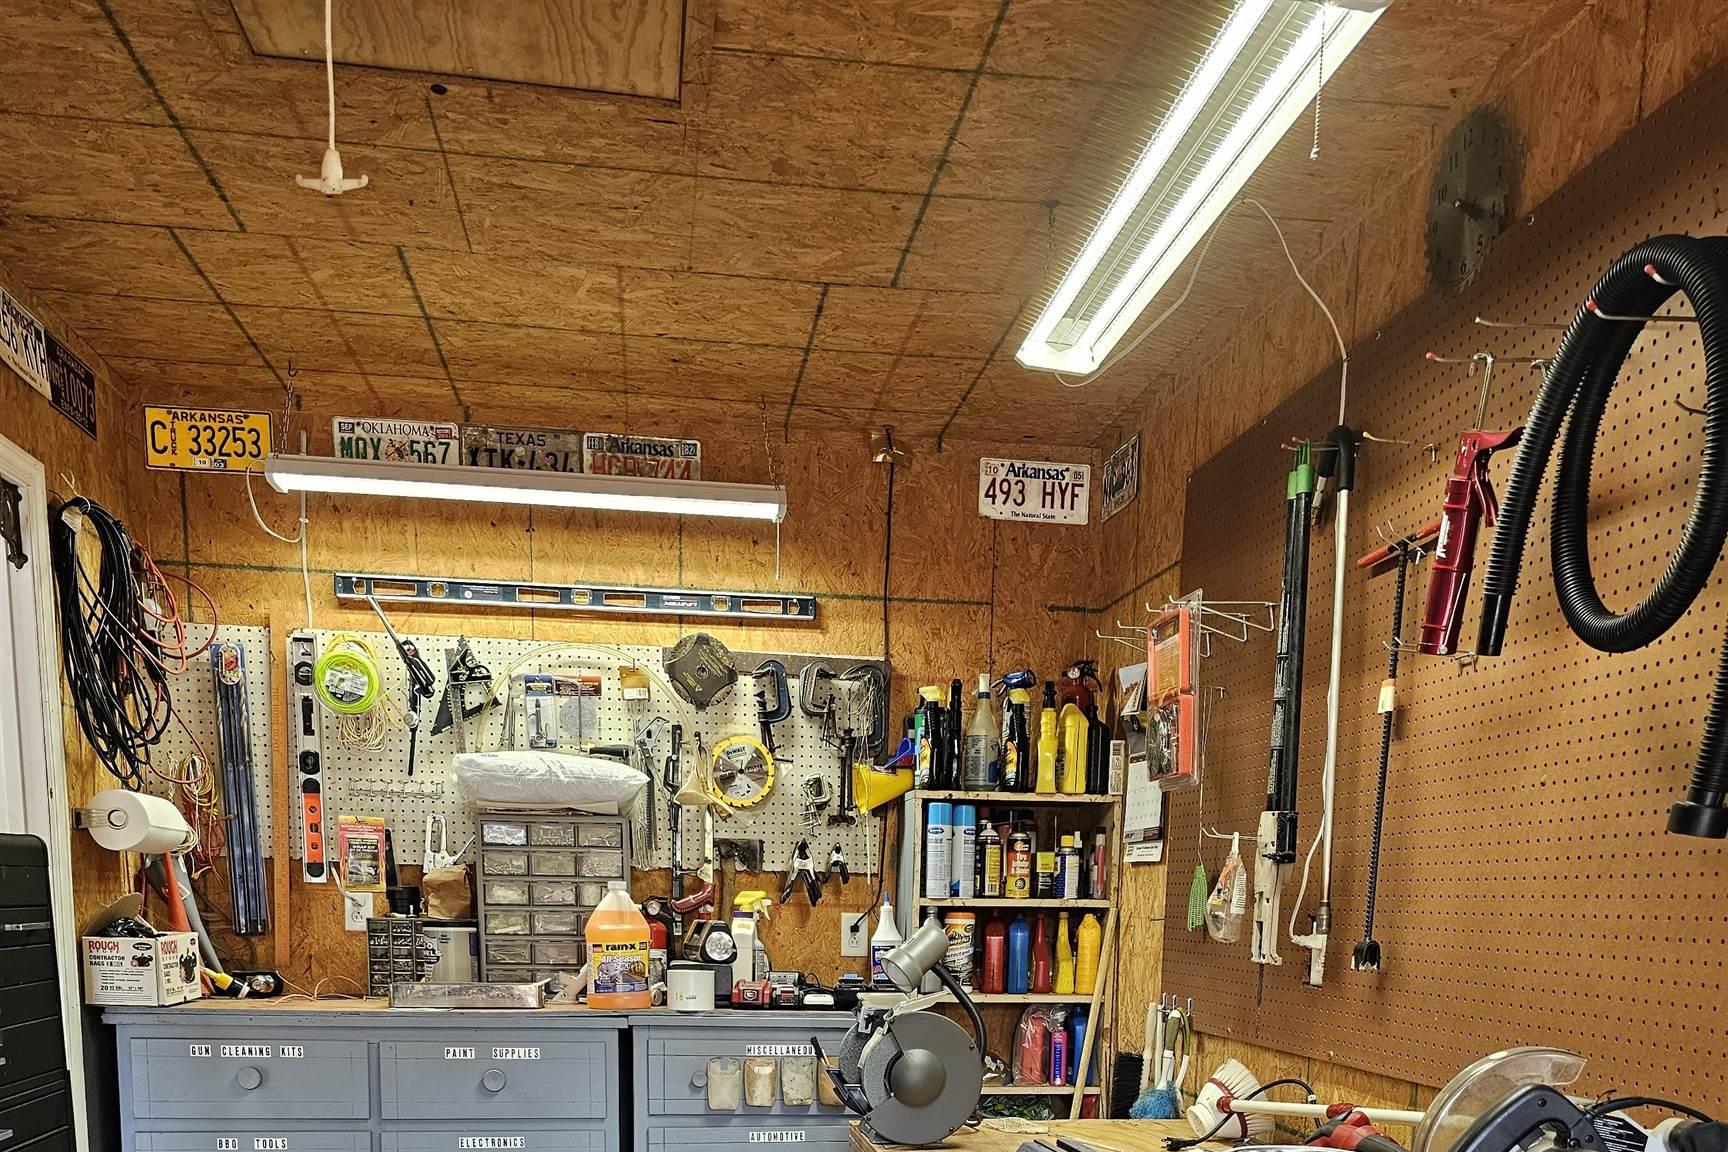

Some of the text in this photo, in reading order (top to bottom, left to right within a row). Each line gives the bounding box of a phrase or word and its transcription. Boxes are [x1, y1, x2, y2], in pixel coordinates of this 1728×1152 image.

[172, 411, 243, 425] ARKANSAS
[362, 421, 430, 437] OKLAHOMA
[150, 420, 262, 458] C 33253
[496, 431, 546, 447] TEXAS
[610, 436, 674, 457] Arkansas
[988, 466, 999, 475] 10
[1005, 462, 1067, 481] Arkansas
[984, 477, 1084, 511] 493 HYF
[1011, 510, 1020, 518] The
[1021, 511, 1042, 519] Natural
[88, 940, 120, 951] ROUGH
[160, 939, 177, 956] ROUGH
[191, 1045, 303, 1058] GUN CLEANING KITS
[446, 1048, 540, 1059] PAINT SUPPLIES
[747, 1045, 815, 1055] MISCELLANEOU
[459, 1136, 525, 1148] ELECTRONICS
[750, 1131, 805, 1142] AUTOMOTIVE
[255, 1138, 288, 1149] TOOLS
